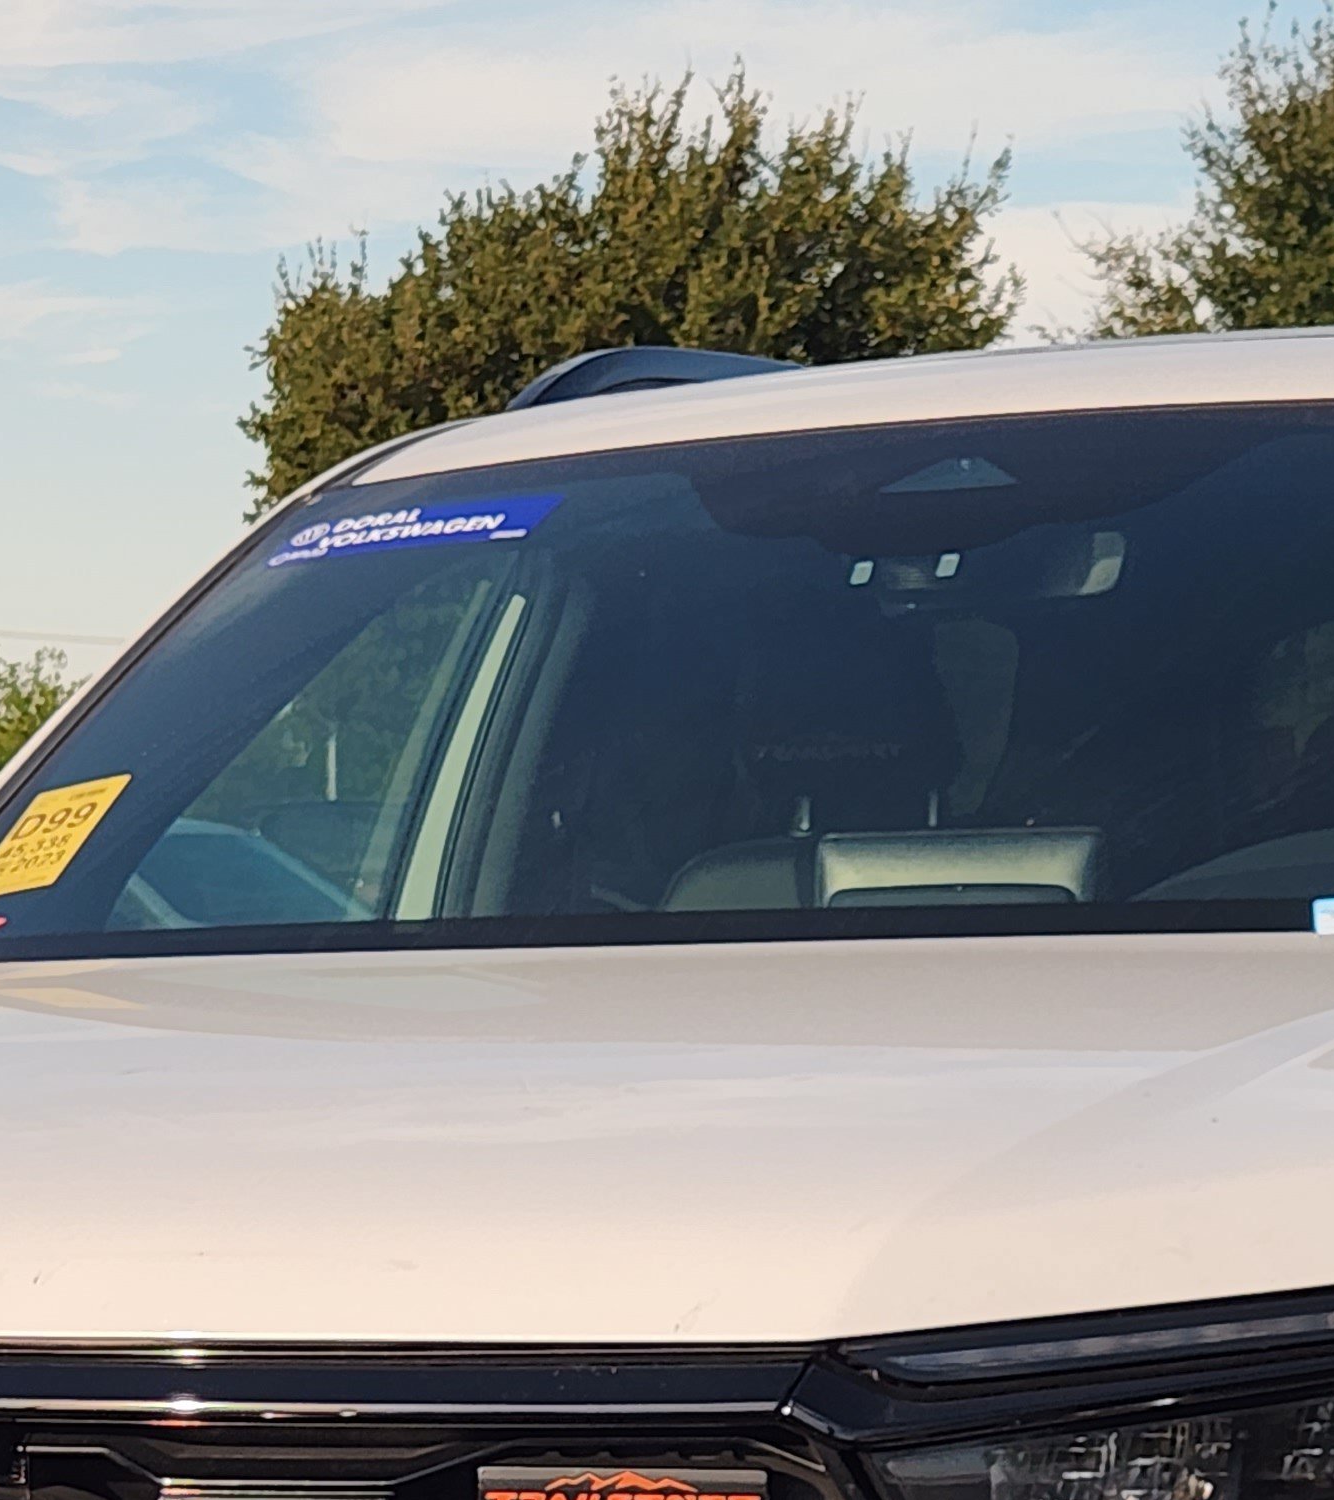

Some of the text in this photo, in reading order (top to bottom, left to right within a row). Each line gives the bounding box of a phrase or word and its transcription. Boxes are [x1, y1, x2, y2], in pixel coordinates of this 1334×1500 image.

[319, 513, 505, 549] VOLKSWAGEN
[333, 508, 421, 533] DORAL
[10, 802, 98, 841] D99
[10, 850, 66, 873] 2023
